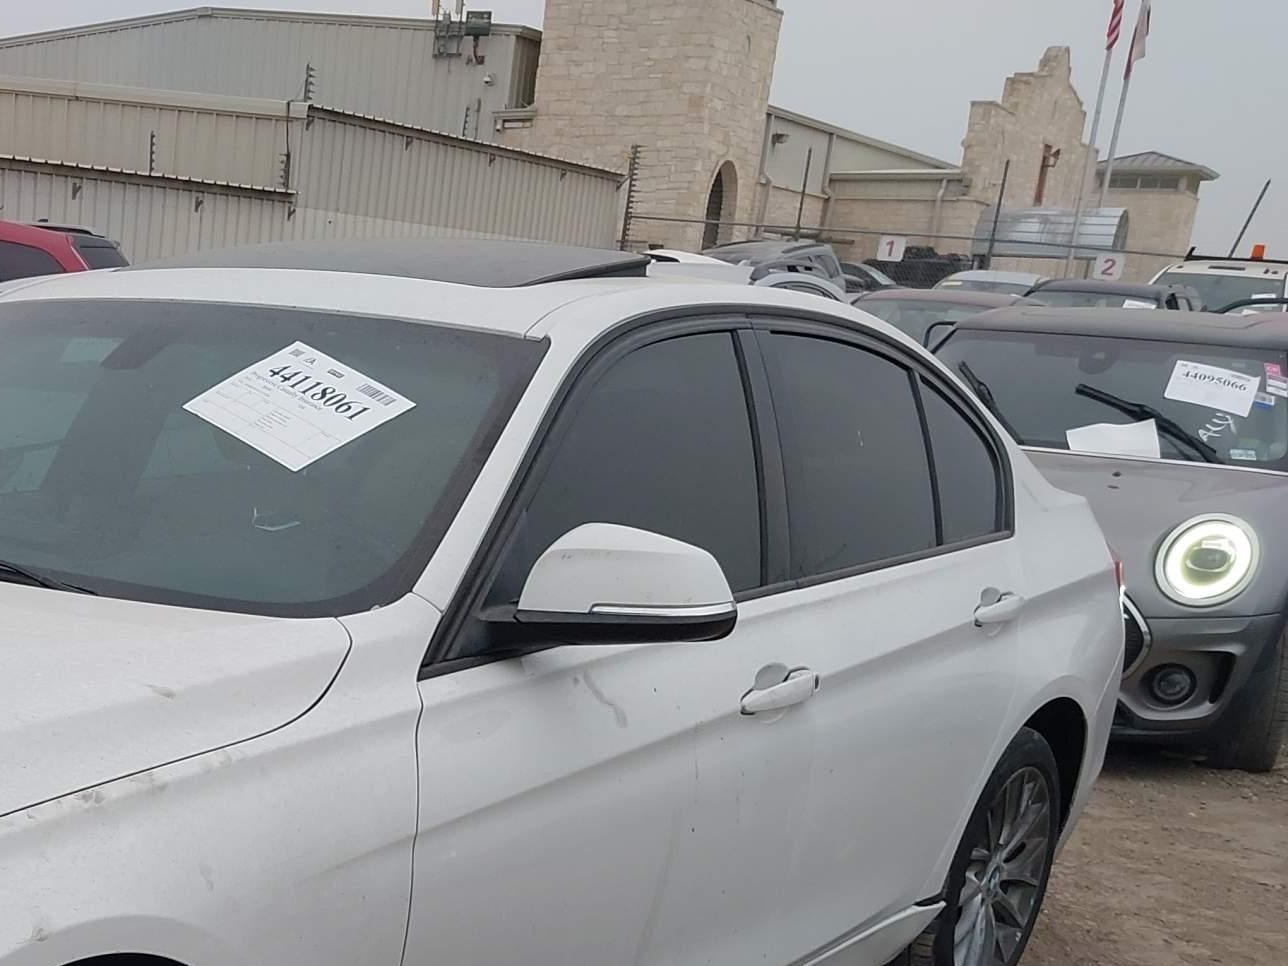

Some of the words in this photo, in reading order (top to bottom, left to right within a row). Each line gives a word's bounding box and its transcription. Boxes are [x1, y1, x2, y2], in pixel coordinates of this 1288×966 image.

[886, 239, 895, 257] 1
[1100, 258, 1117, 277] 2
[1182, 370, 1247, 391] 44095066
[269, 365, 371, 421] 44118061
